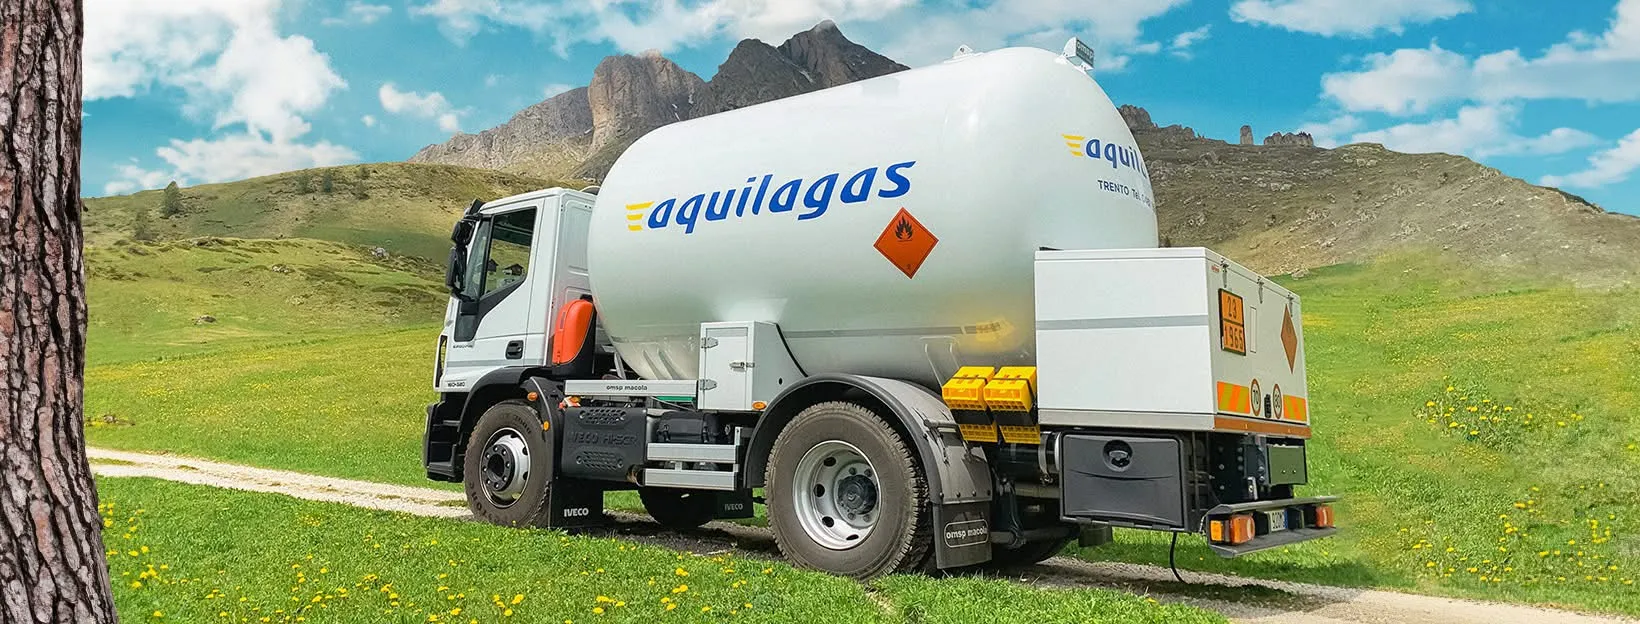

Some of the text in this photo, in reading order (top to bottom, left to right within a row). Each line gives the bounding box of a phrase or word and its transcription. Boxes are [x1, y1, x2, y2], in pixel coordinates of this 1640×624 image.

[1097, 179, 1130, 196] TRENTO
[647, 160, 917, 234] aquilagas
[1227, 295, 1238, 320] 23
[1223, 324, 1244, 351] 1965
[1252, 389, 1259, 405] 70
[563, 507, 590, 518] IVECO
[724, 503, 744, 512] IVECO
[946, 525, 988, 540] omsp macola
